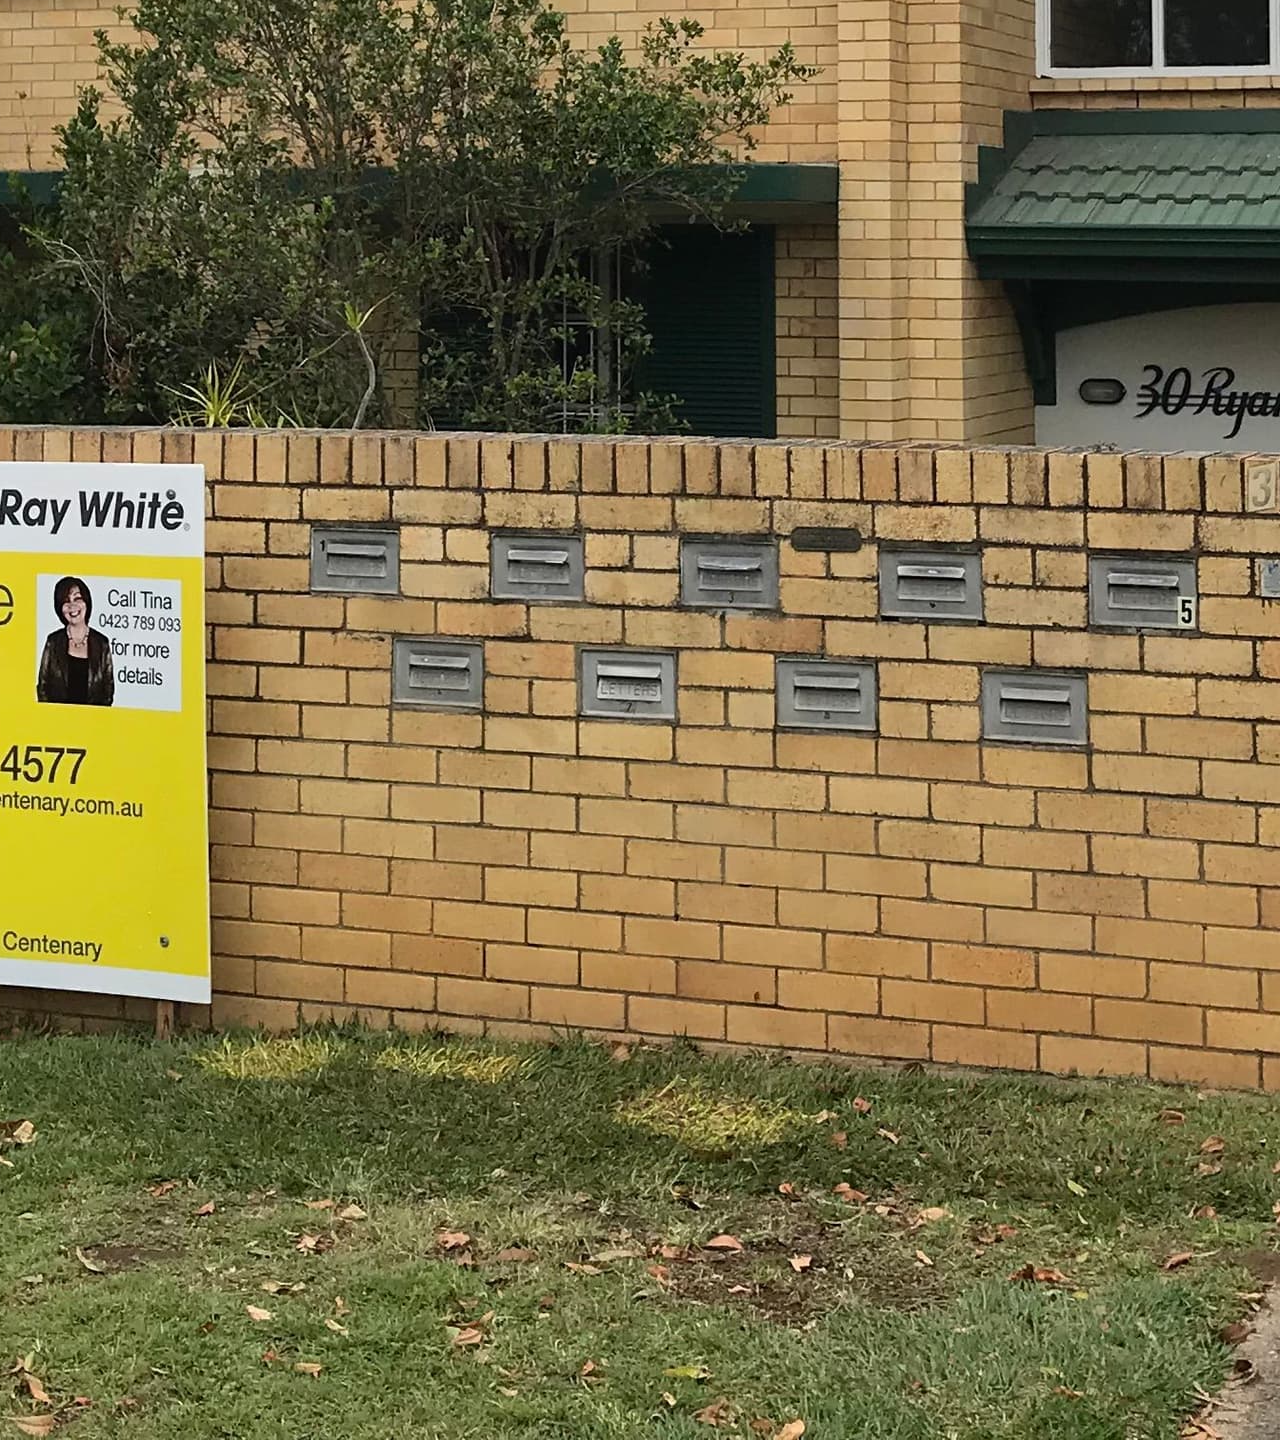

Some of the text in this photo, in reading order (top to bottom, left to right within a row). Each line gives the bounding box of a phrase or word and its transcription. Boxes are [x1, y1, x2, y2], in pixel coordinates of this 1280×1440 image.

[1134, 364, 1192, 418] 30
[78, 490, 184, 531] White
[107, 589, 173, 611] Call Tina
[1180, 599, 1193, 625] 5
[98, 613, 182, 633] 0423 789 093
[110, 638, 170, 659] for more
[117, 666, 163, 686] details
[0, 745, 87, 785] 4577
[3, 931, 103, 962] Centenary
